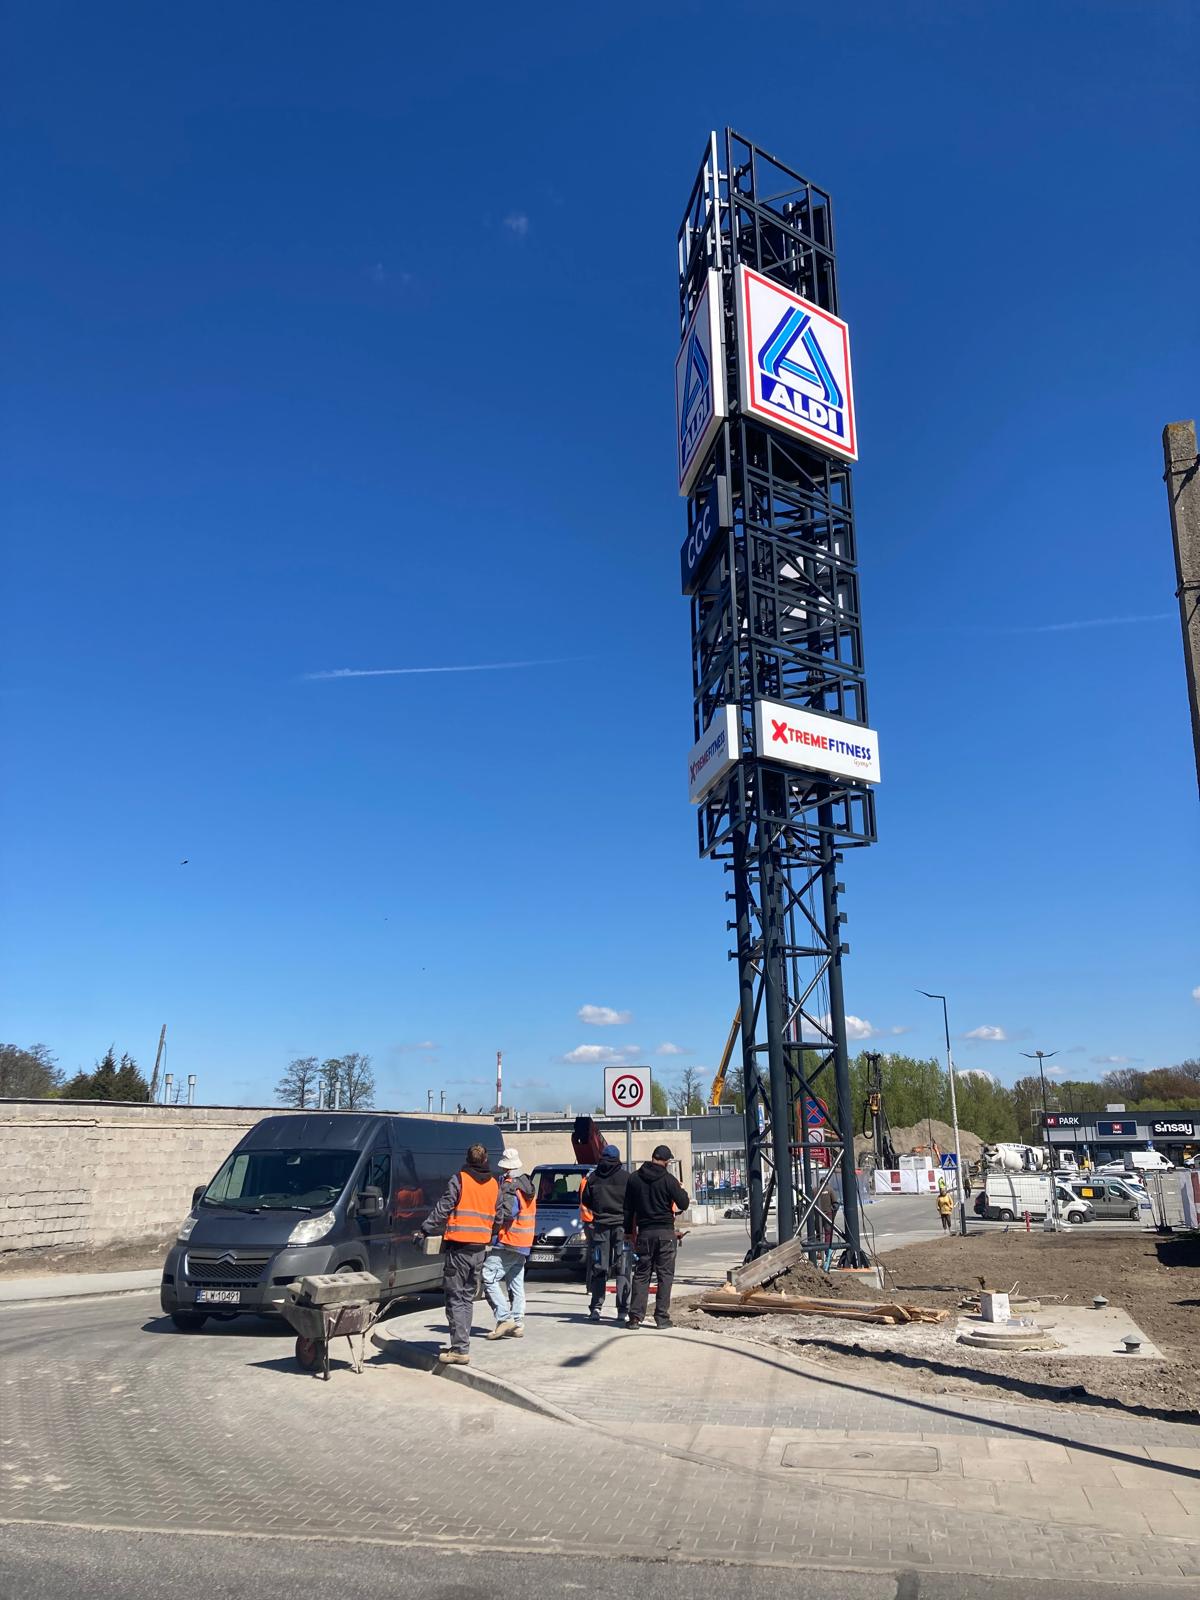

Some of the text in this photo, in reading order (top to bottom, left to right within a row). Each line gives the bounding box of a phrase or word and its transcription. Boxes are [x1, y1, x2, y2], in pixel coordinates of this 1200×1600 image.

[769, 382, 838, 433] ALDI
[684, 392, 708, 462] ALDI
[687, 505, 711, 569] CCC
[617, 1083, 639, 1099] 20
[1059, 1117, 1080, 1125] PARK
[1155, 1121, 1193, 1135] sinsay
